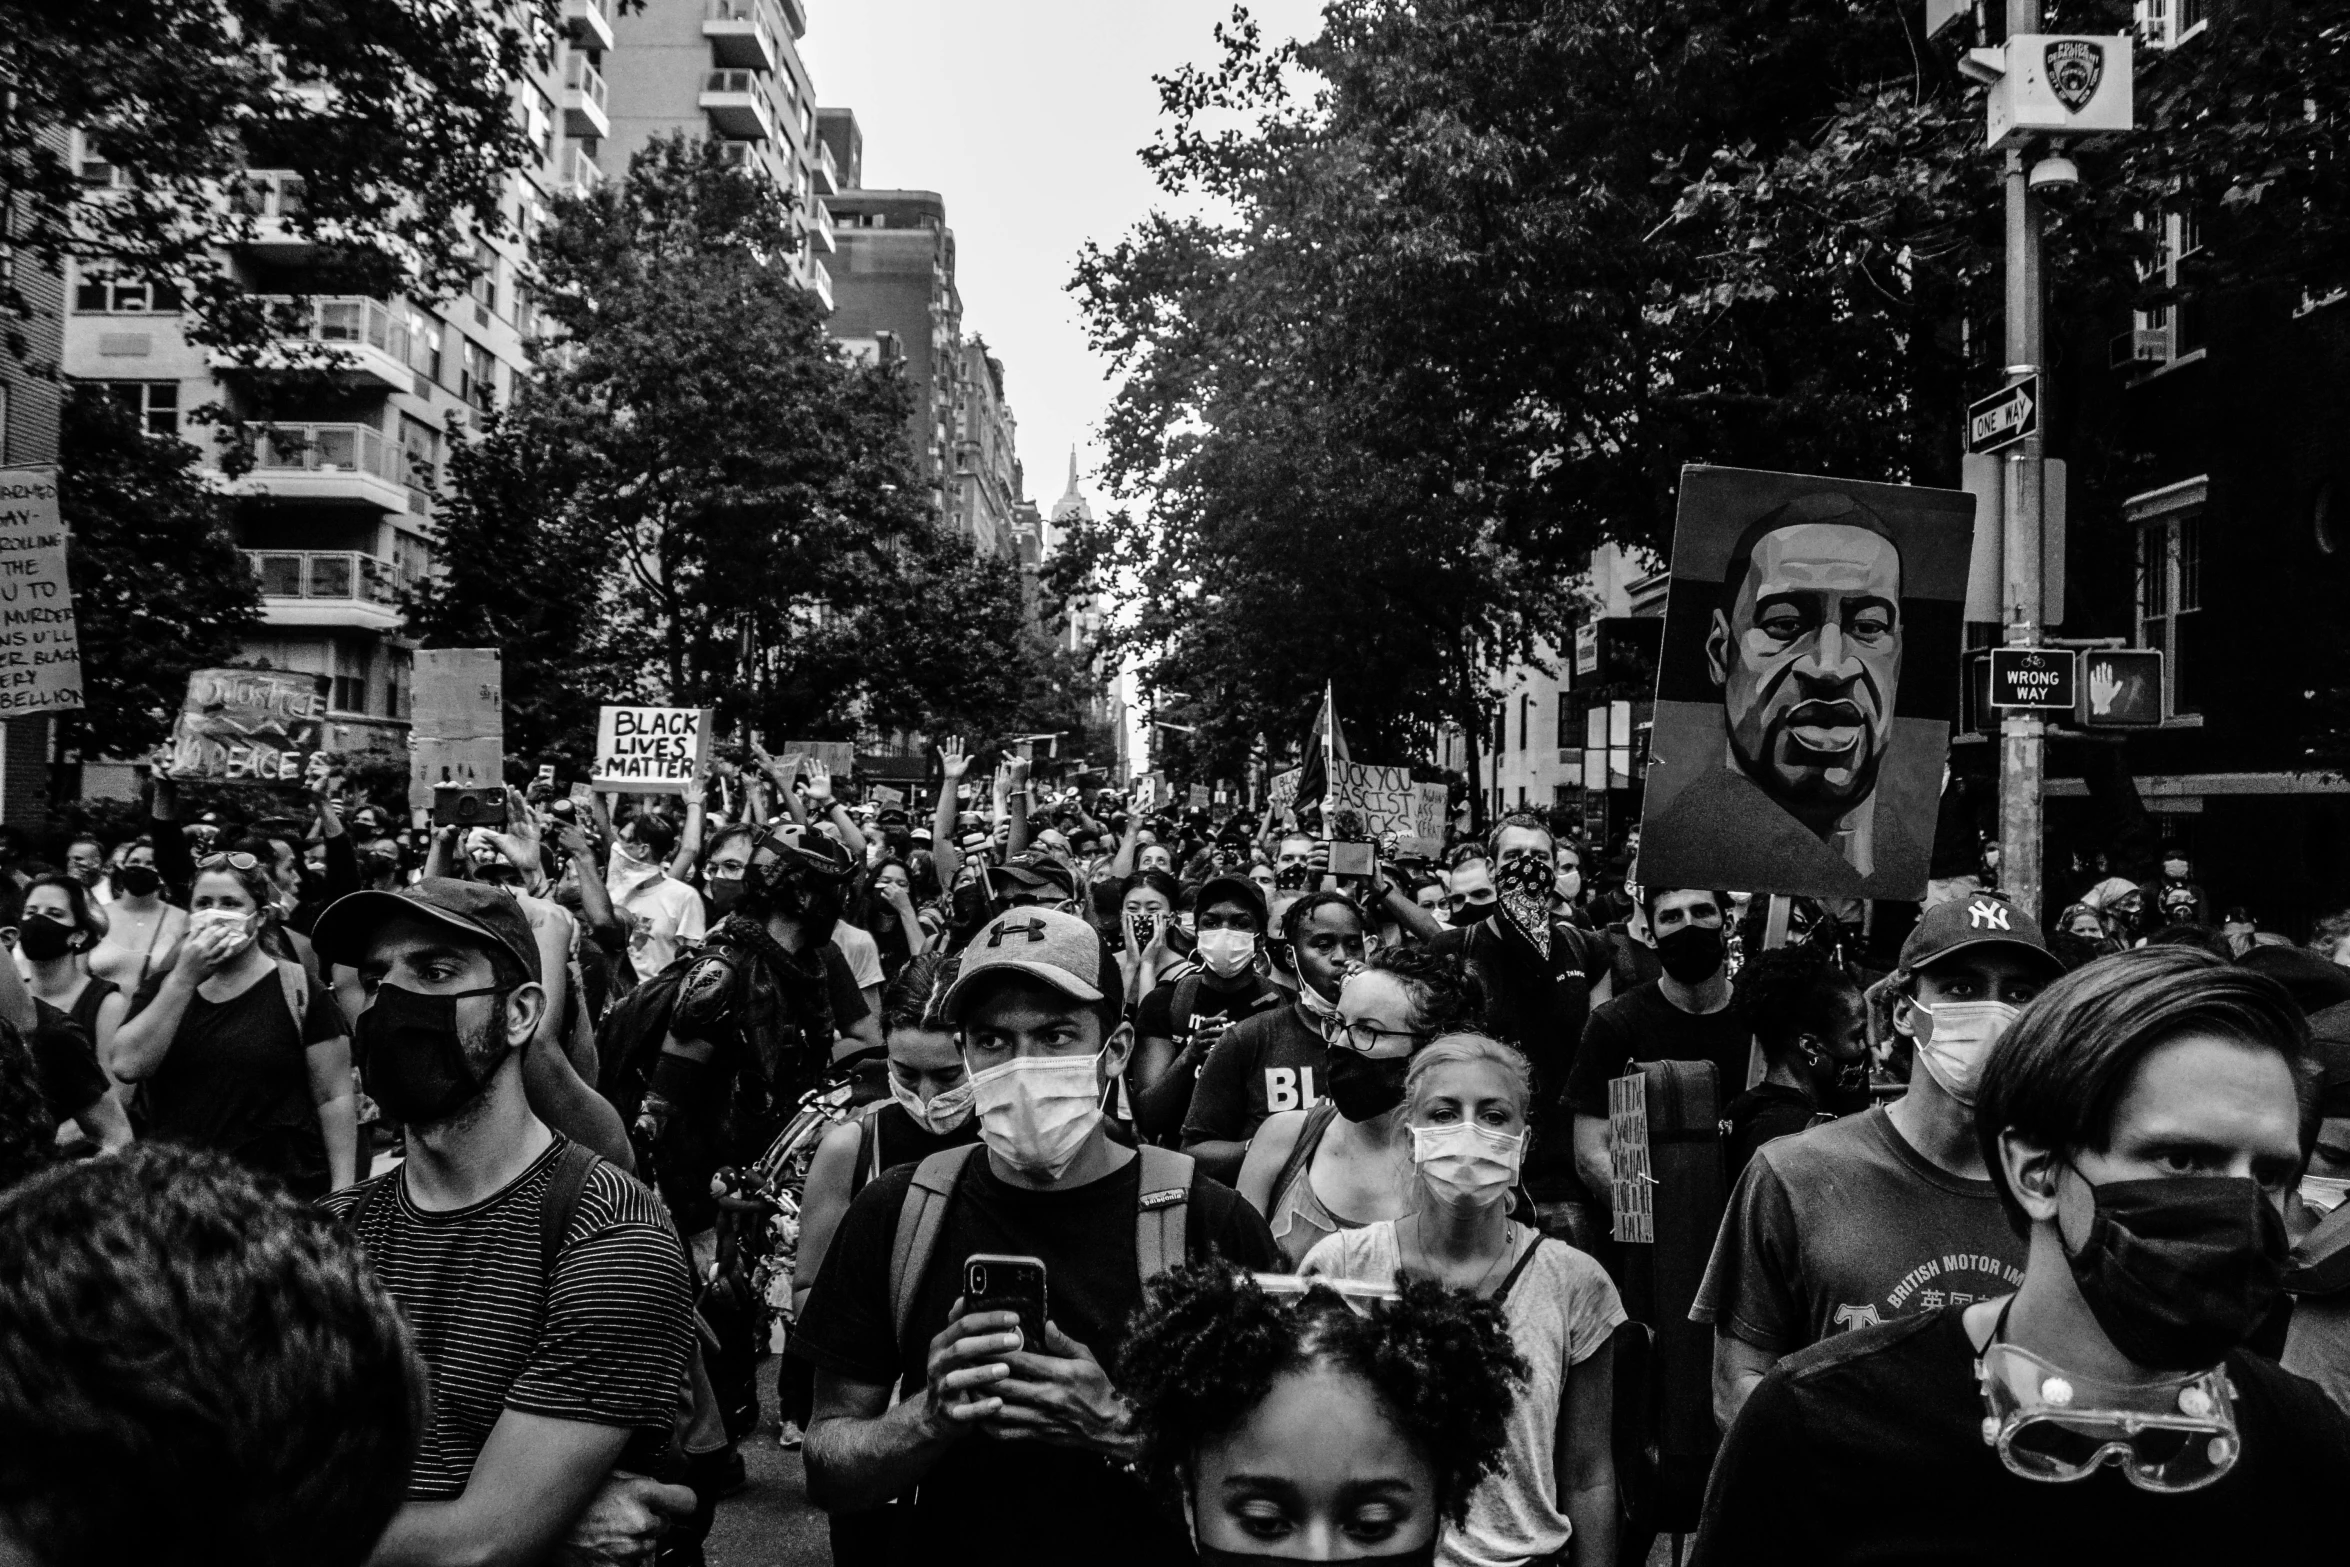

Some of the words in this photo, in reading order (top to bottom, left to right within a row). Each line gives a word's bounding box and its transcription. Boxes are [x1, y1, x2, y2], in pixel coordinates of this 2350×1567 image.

[2057, 43, 2090, 55] POLICE
[1977, 411, 1997, 437] ONE
[2005, 397, 2027, 426] WAY
[1, 559, 40, 576] THE
[1, 583, 18, 601] U
[26, 581, 57, 599] TO
[4, 607, 75, 627] MURDER
[34, 647, 80, 666] BLACK
[2007, 670, 2059, 686] WRONG
[0, 688, 84, 709] BELLION
[2017, 687, 2048, 700] WAY
[615, 710, 698, 736] BLACK
[615, 736, 687, 760] LIVES
[206, 746, 300, 781] PEACE
[606, 756, 694, 779] MATTER
[1374, 766, 1412, 792] YOU
[1415, 803, 1434, 822] ASS
[1968, 900, 2011, 931] NY
[1265, 1066, 1335, 1113] BL
[1886, 1259, 1940, 1309] BRITISH
[1942, 1253, 2001, 1276] MOTOR
